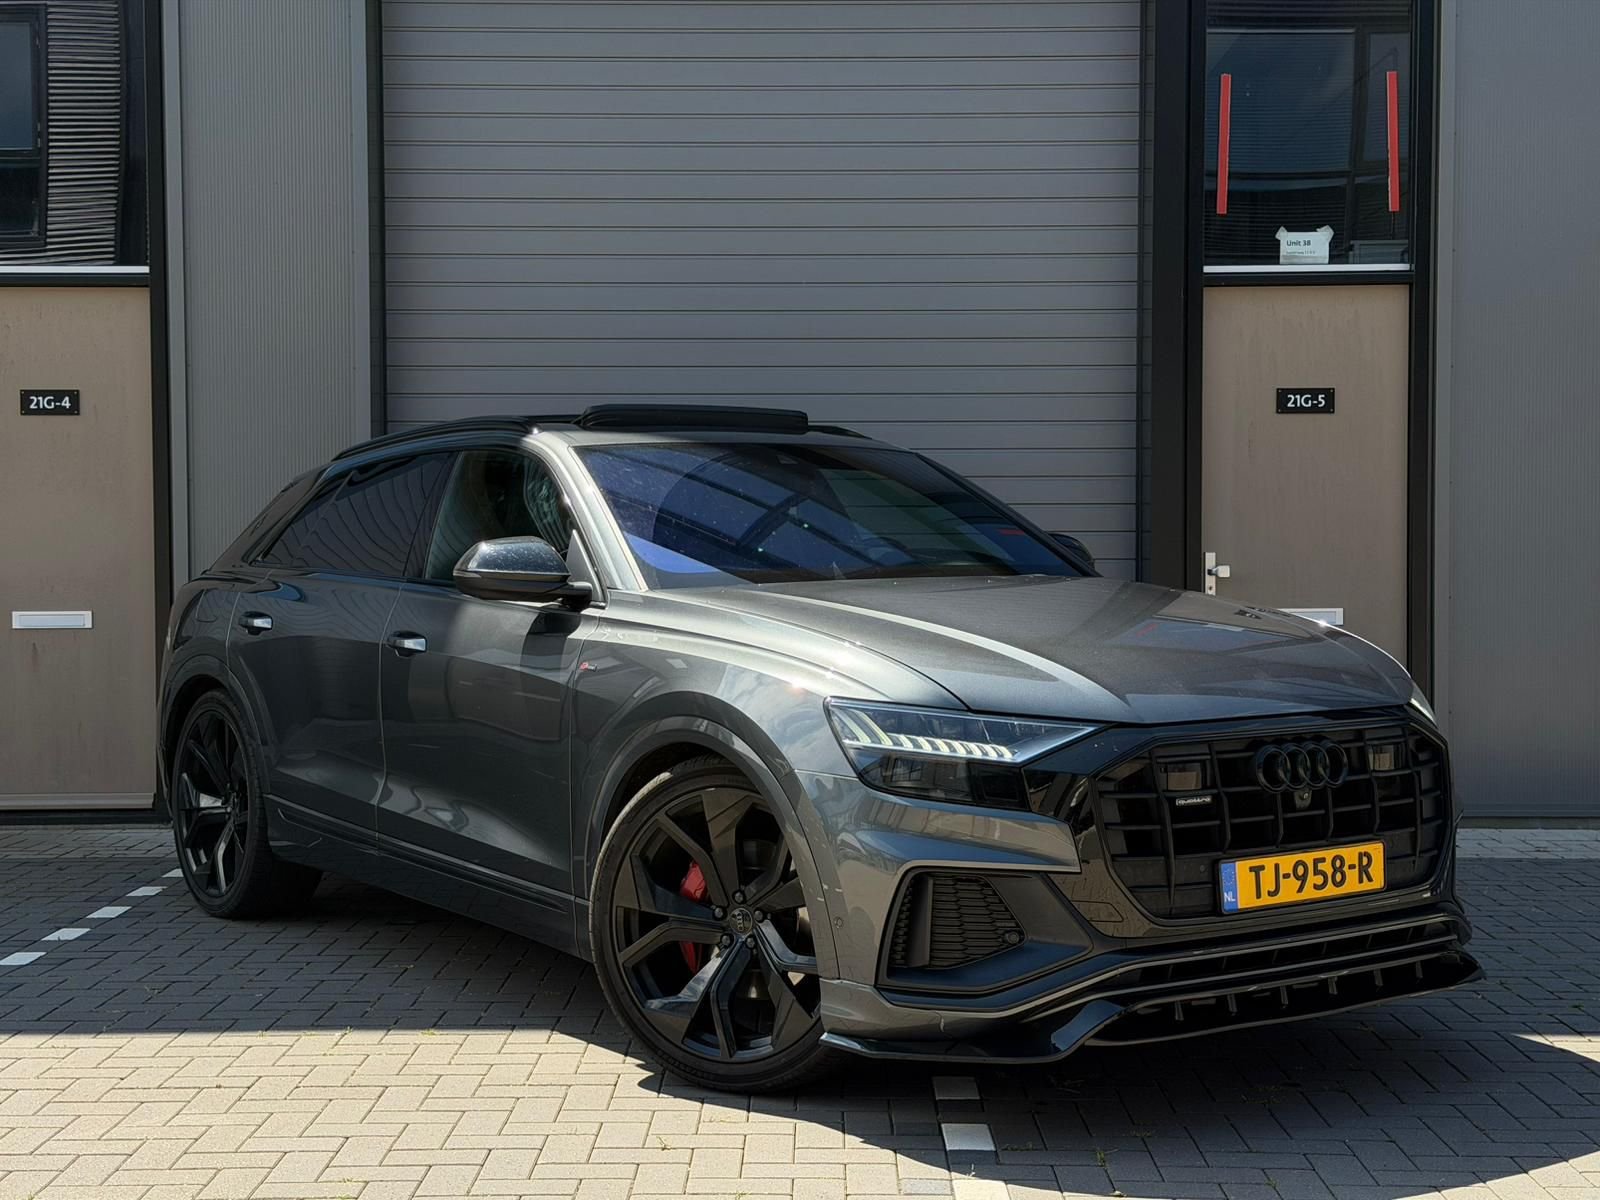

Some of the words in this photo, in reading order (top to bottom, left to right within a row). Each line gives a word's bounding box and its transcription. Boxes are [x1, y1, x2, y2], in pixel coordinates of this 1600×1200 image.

[1286, 239, 1301, 247] Unit
[1302, 239, 1312, 247] 38
[29, 396, 71, 409] 21G-4
[1287, 394, 1326, 407] 21G-5
[1223, 892, 1236, 902] NL
[1249, 851, 1374, 899] TJ-958-R
